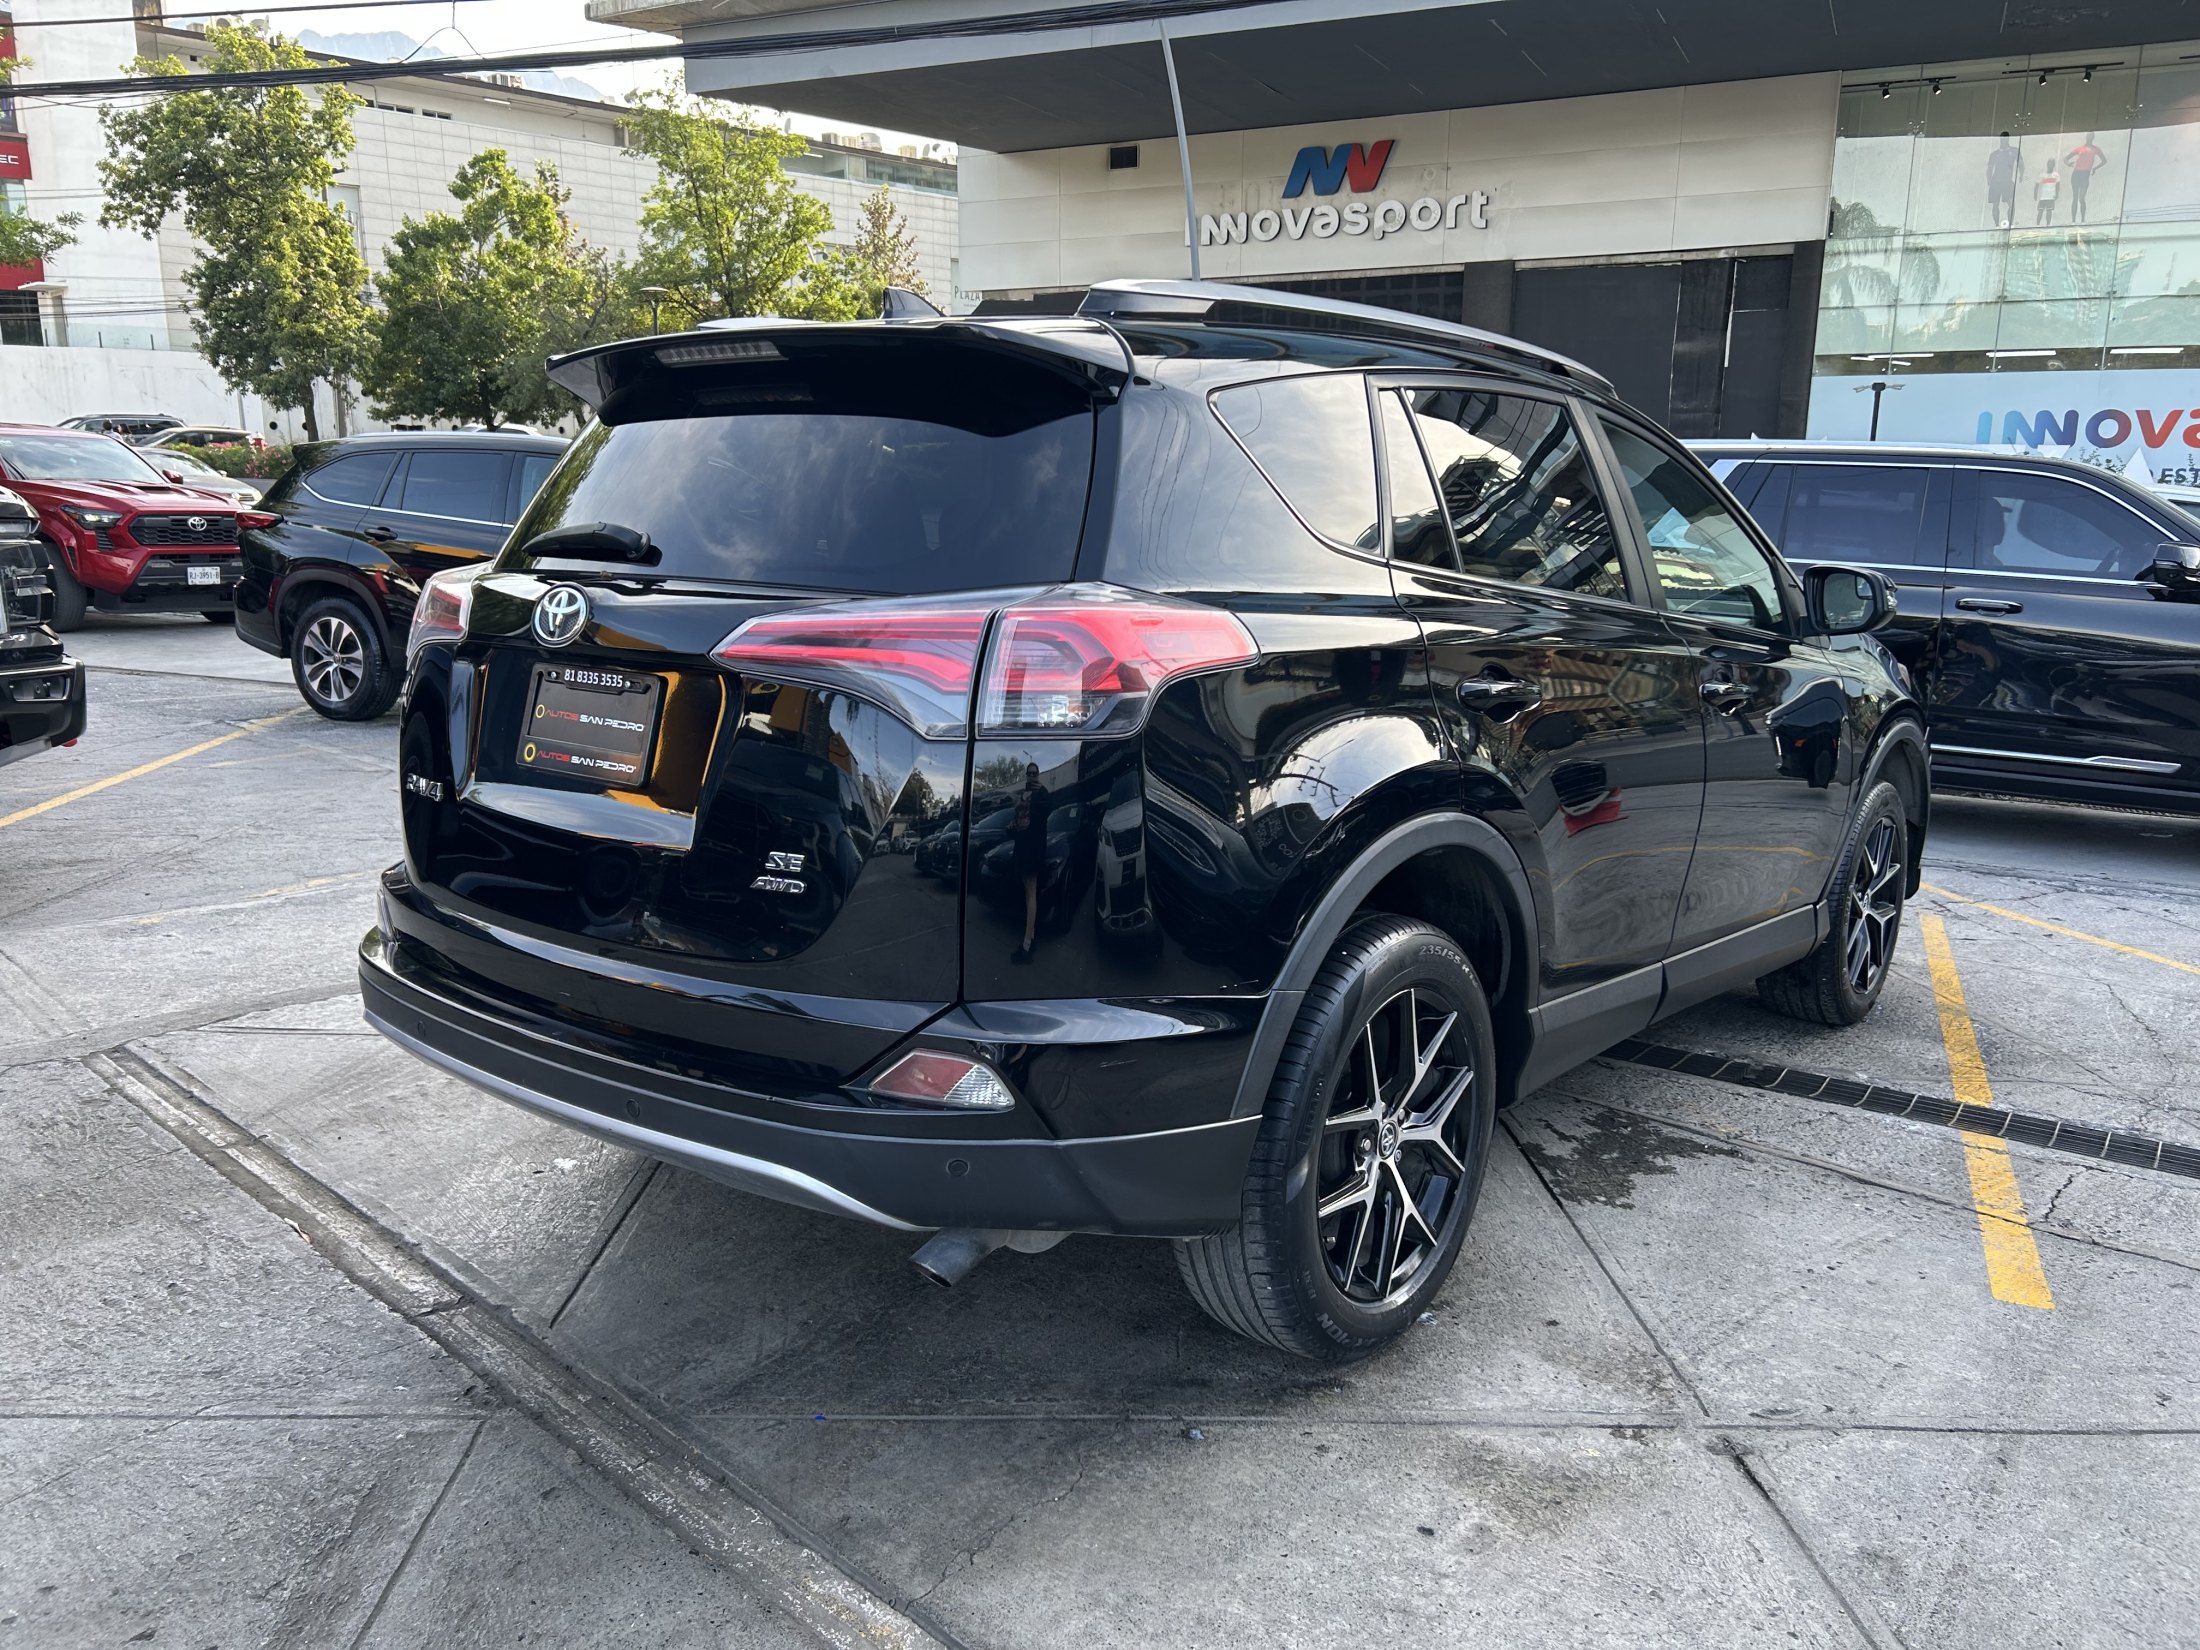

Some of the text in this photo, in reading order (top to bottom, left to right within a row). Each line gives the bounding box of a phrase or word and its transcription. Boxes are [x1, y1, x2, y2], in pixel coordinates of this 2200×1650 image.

[564, 668, 623, 687] 81 8335 3535
[545, 709, 645, 732] AUTOS SAN PEDRO
[537, 750, 637, 773] AUTOS SAN PEDRO
[765, 851, 805, 873] SE
[749, 875, 807, 894] AWD
[1419, 944, 1462, 964] 235/55
